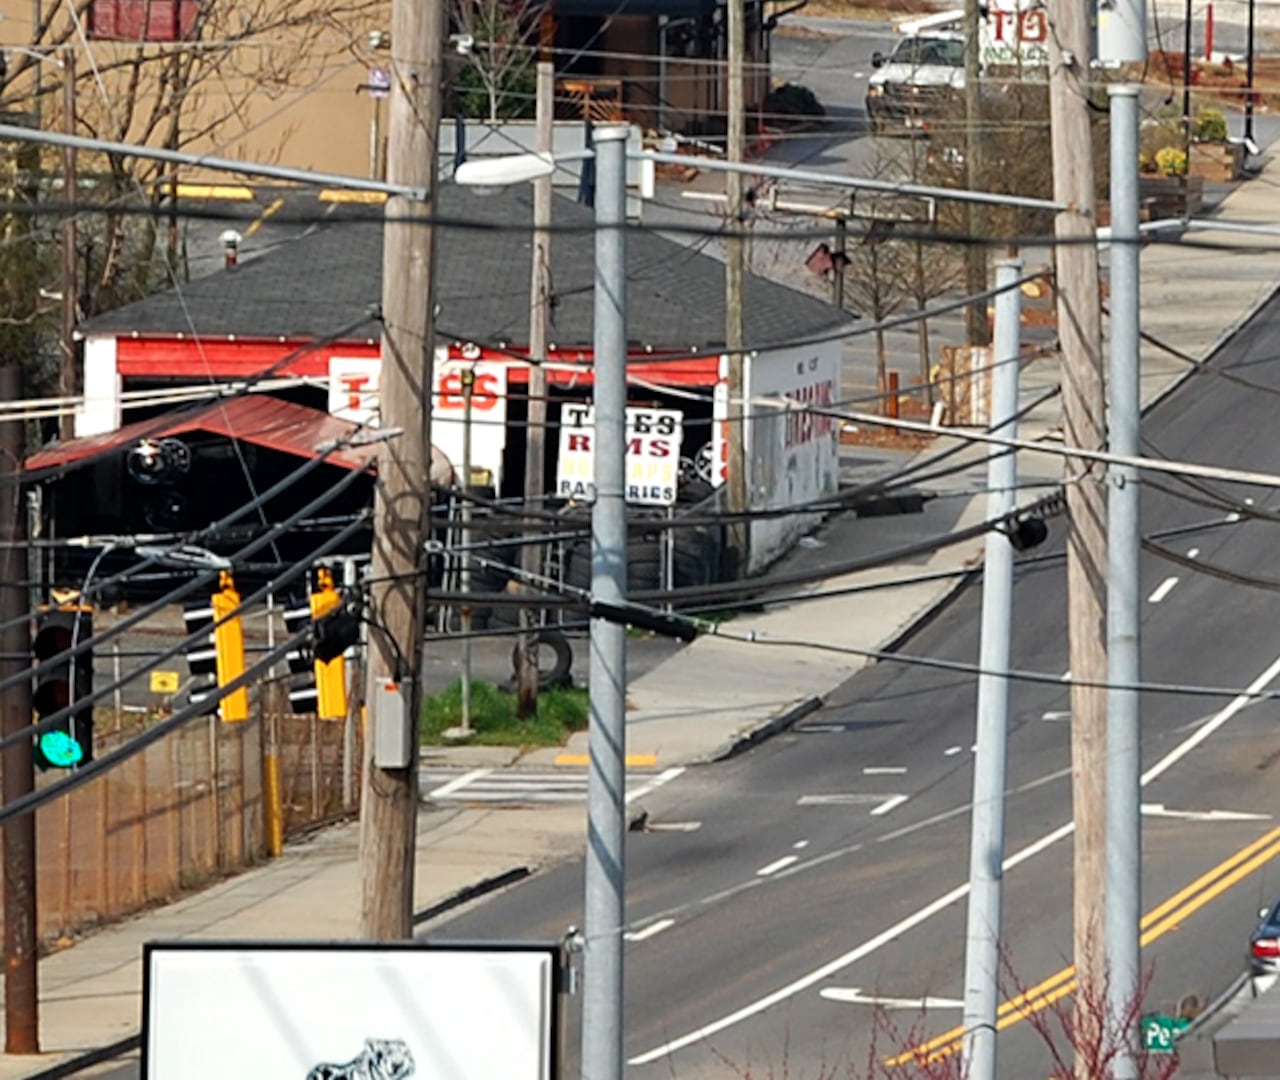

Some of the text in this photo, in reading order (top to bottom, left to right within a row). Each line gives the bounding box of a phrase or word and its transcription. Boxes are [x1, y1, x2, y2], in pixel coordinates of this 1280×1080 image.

[340, 374, 499, 411] TES
[568, 409, 676, 435] TES
[568, 434, 671, 457] RMS
[561, 481, 673, 501] BARIES
